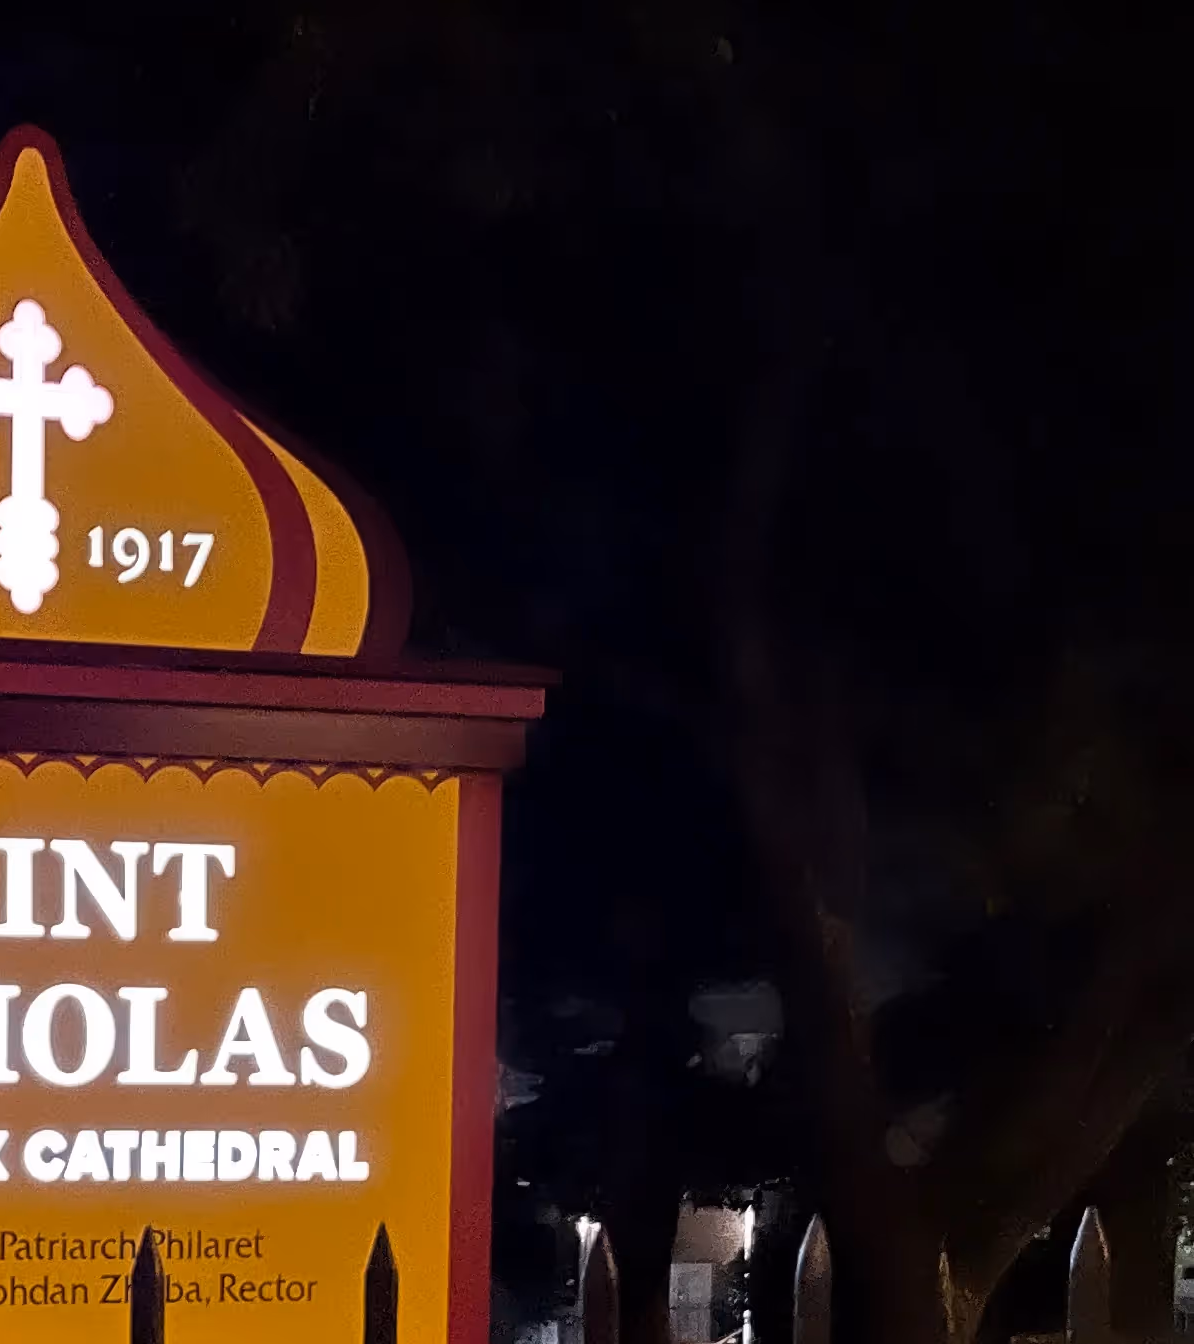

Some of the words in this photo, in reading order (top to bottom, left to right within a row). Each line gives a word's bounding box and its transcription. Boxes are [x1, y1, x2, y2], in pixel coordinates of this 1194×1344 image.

[88, 525, 214, 587] 1917
[23, 1130, 370, 1182] CATHEDRAL
[0, 1230, 137, 1261] Patriarch
[150, 1228, 265, 1260] Philaret
[99, 1273, 211, 1308] Zhba,
[219, 1272, 318, 1303] Rector
